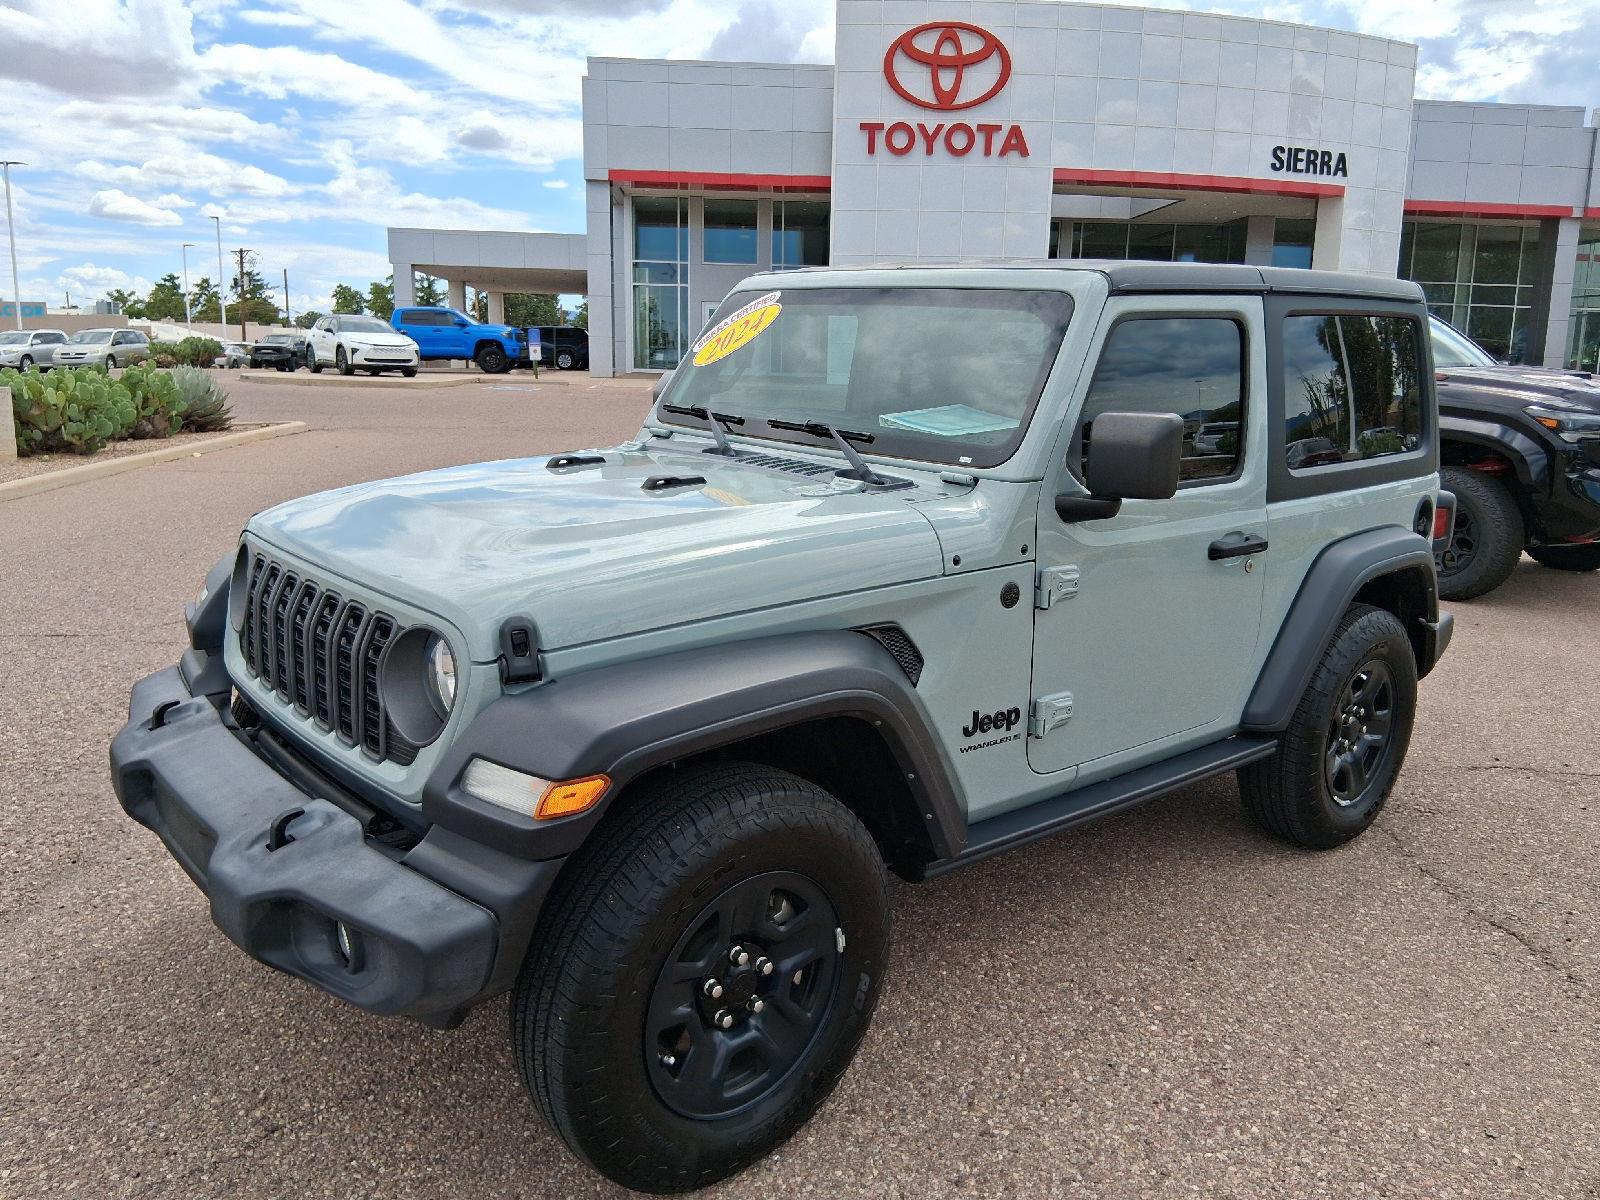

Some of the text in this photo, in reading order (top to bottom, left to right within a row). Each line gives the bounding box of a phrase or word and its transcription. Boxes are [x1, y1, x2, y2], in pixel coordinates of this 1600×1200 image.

[859, 122, 1030, 158] TOYOTA
[1270, 145, 1349, 178] SIERRA
[698, 294, 777, 349] SIERRA CERTIFIED
[705, 307, 768, 362] 2024
[962, 706, 1020, 737] Jeep
[959, 736, 1012, 753] WRANGLER
